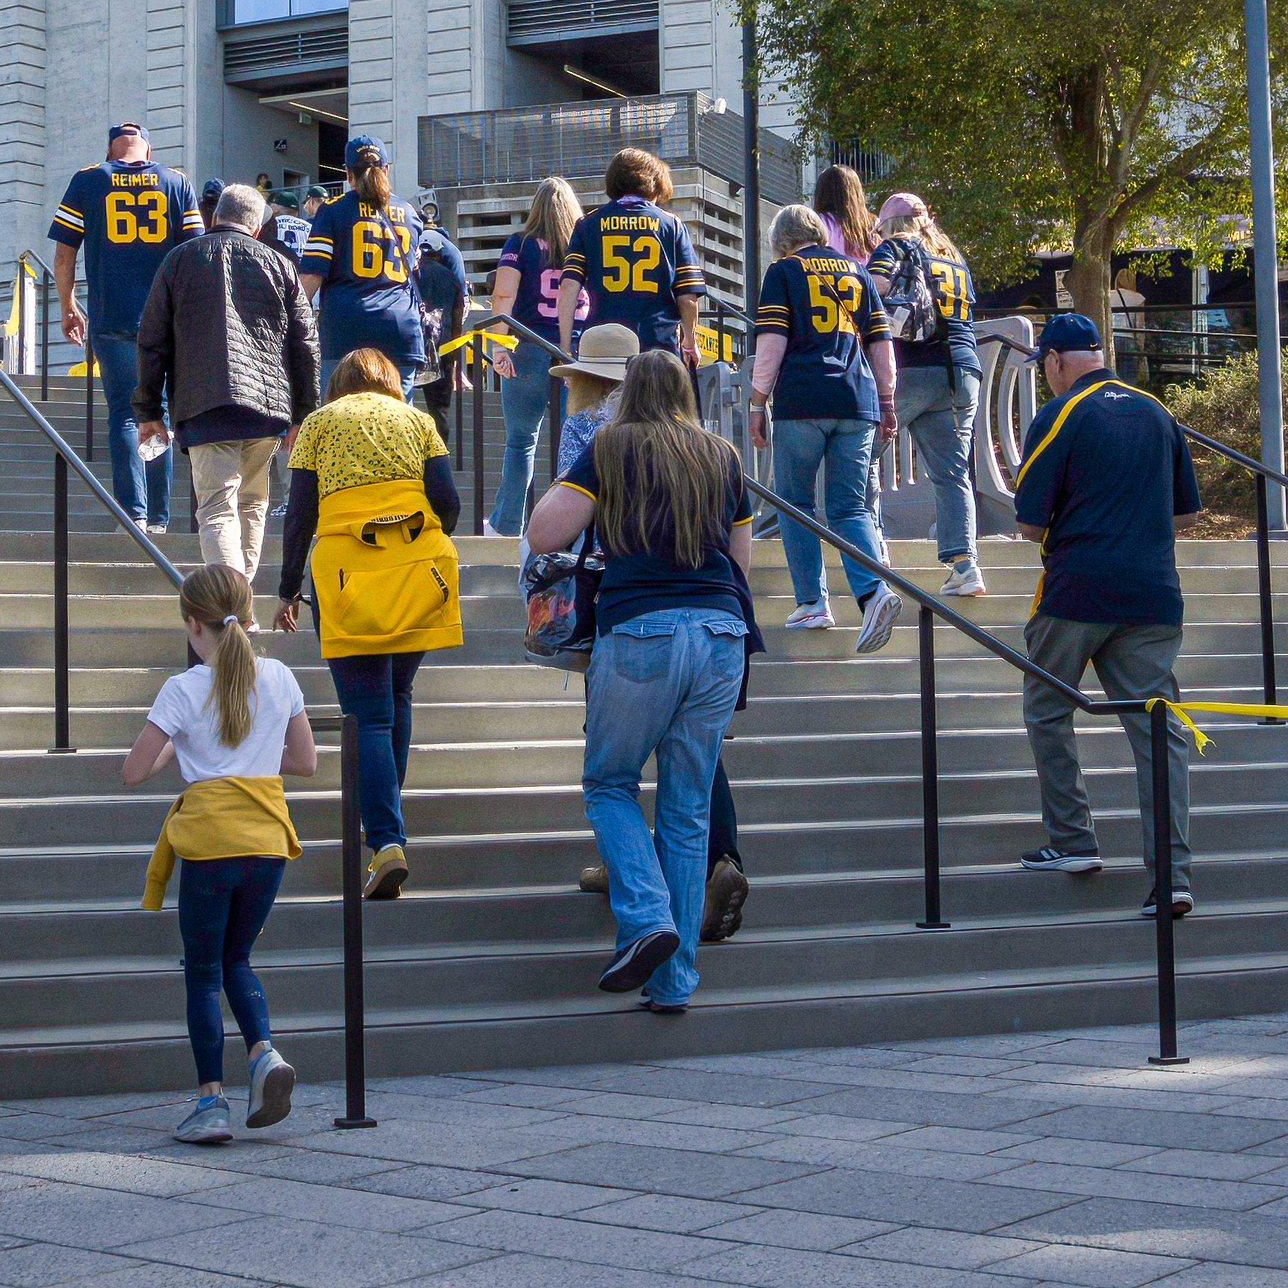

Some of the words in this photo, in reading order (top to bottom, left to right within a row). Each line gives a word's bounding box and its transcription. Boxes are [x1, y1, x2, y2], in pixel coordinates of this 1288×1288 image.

[111, 173, 158, 187] REIMER
[105, 190, 167, 243] 63
[600, 216, 660, 232] MORROW
[352, 221, 411, 283] 63
[602, 235, 661, 293] 52
[800, 258, 859, 274] MORROW
[806, 275, 863, 336] 52
[930, 262, 970, 320] 31
